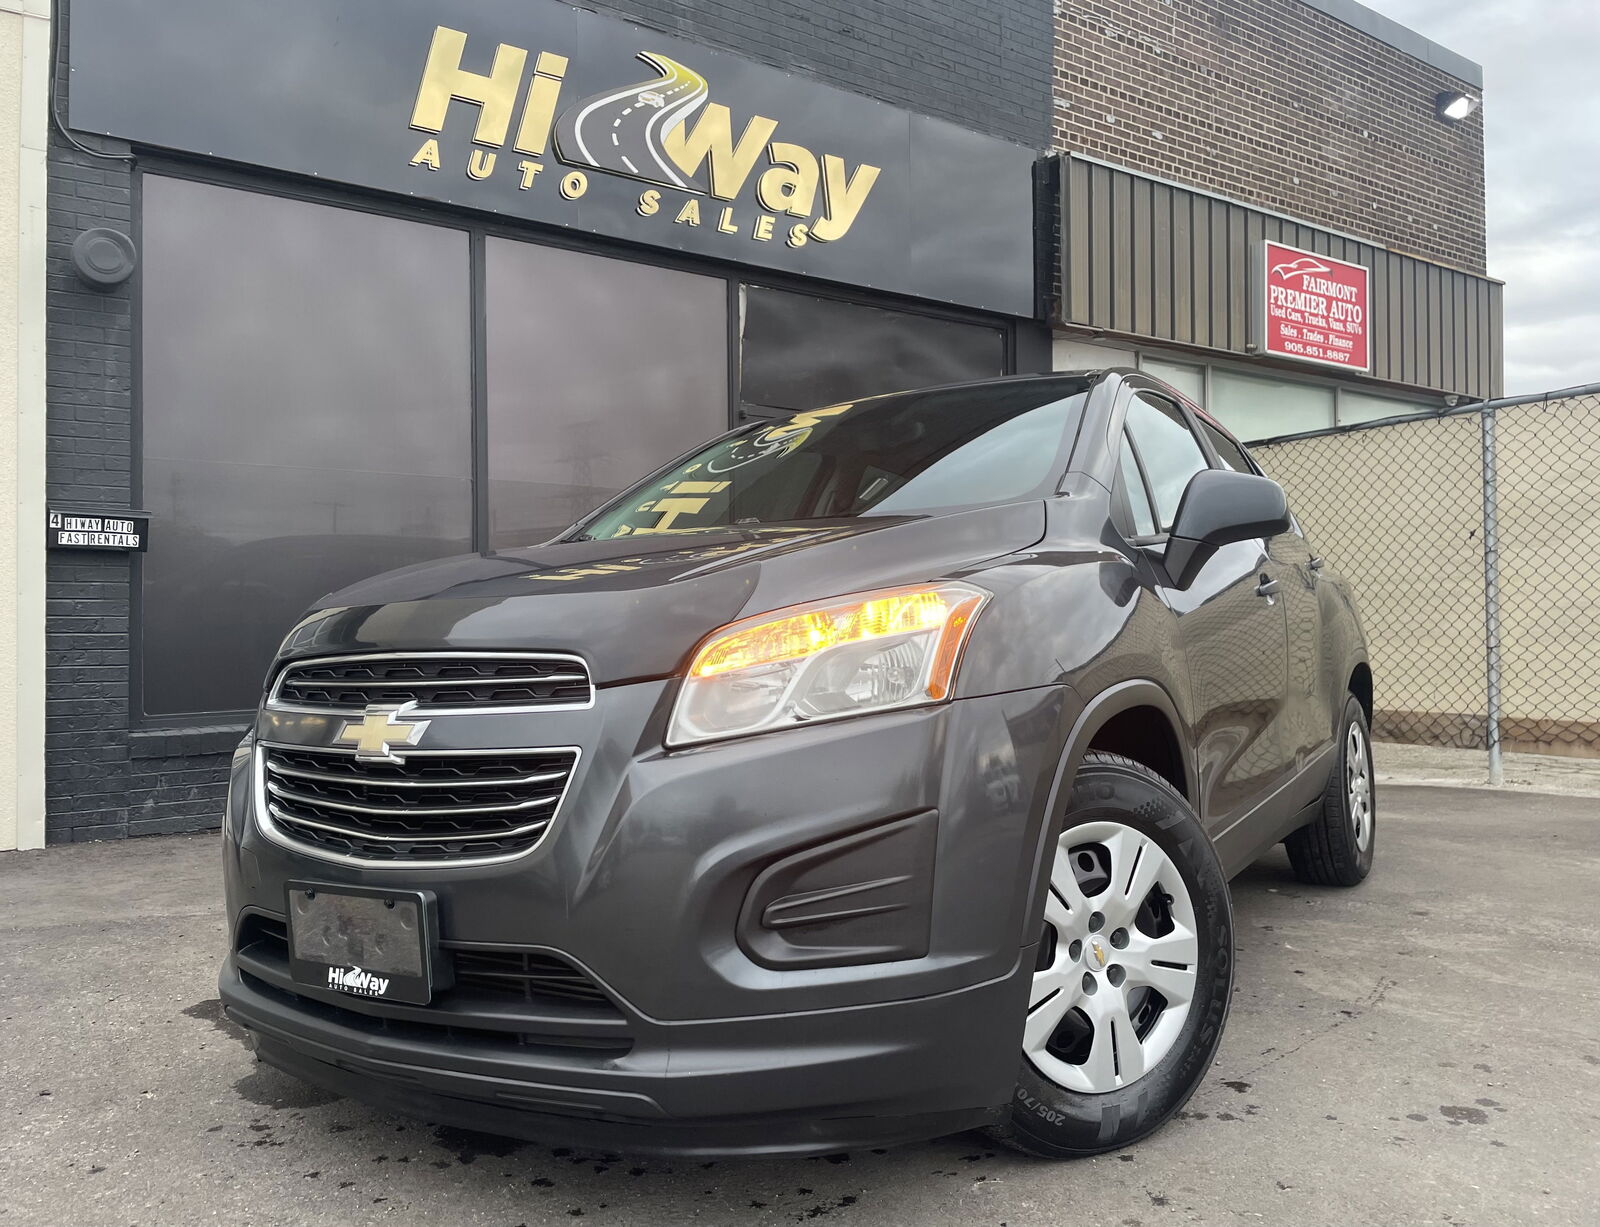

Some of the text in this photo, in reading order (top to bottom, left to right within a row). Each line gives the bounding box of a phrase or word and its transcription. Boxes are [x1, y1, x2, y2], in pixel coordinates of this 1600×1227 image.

[408, 139, 810, 248] AUTO SALES
[1302, 274, 1358, 302] FAIRMONT
[1270, 284, 1362, 323] PREMIER AUTO
[1270, 304, 1286, 318] Used
[1346, 322, 1362, 335] SUVs
[1280, 323, 1353, 349] Sales Trades Finance
[1284, 341, 1350, 362] 905.851.8887
[51, 514, 133, 533] 4 HIWAY AUTO
[59, 532, 138, 546] FAST RENTALS
[1016, 1088, 1067, 1126] 205/70
